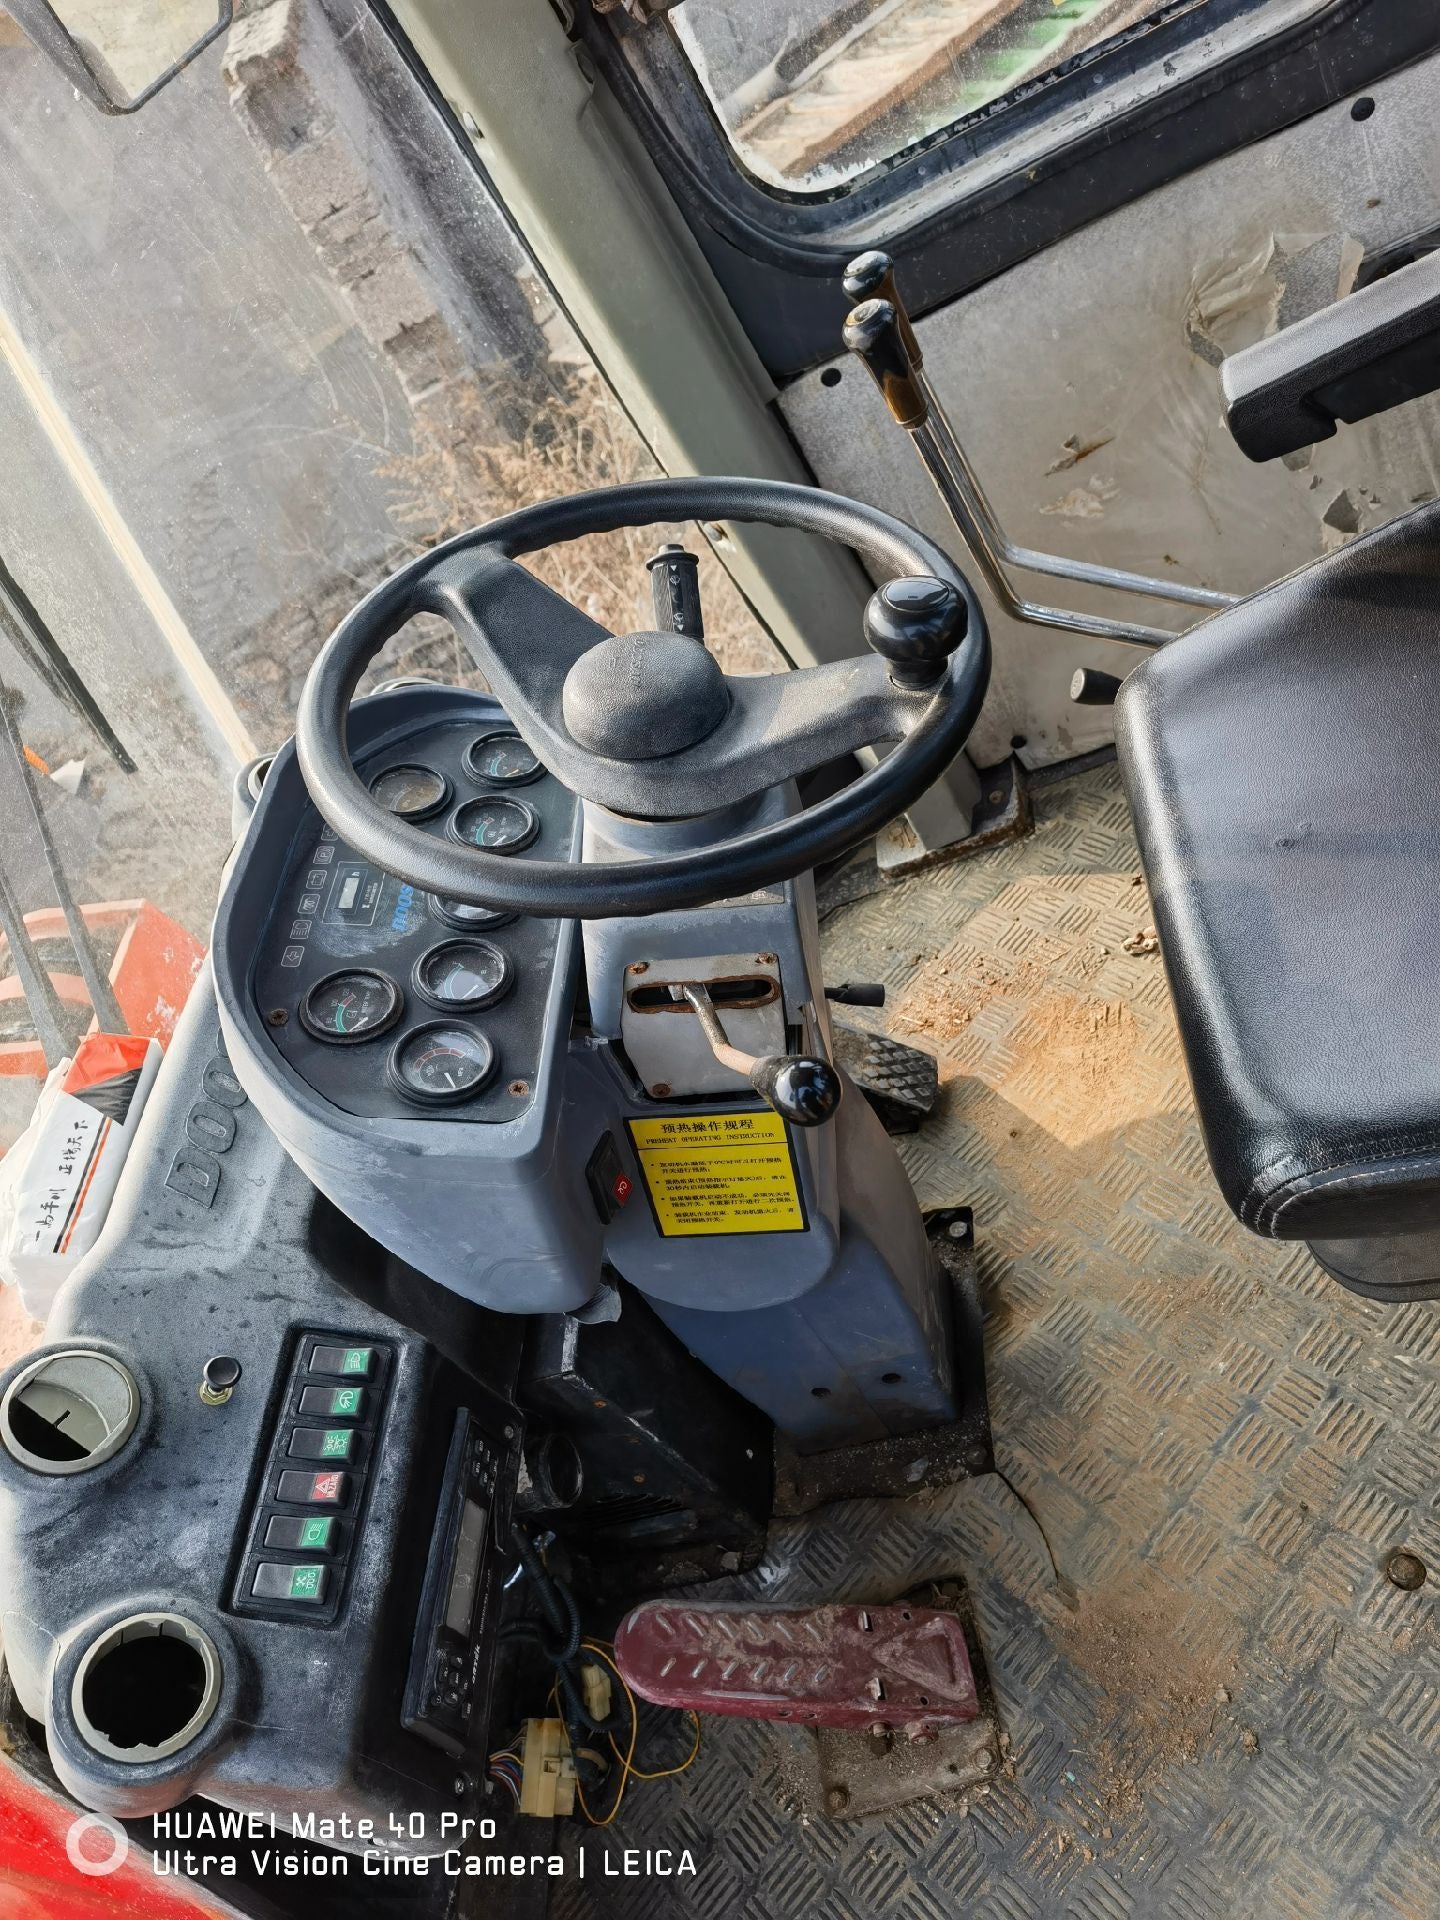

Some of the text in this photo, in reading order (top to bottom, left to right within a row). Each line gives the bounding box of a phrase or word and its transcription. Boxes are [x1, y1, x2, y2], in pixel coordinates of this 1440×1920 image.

[164, 1024, 249, 1209] DOO
[660, 1119, 755, 1134] 预热操作规程
[680, 1134, 722, 1143] OPERATING
[725, 1132, 775, 1141] INSTRUCTION
